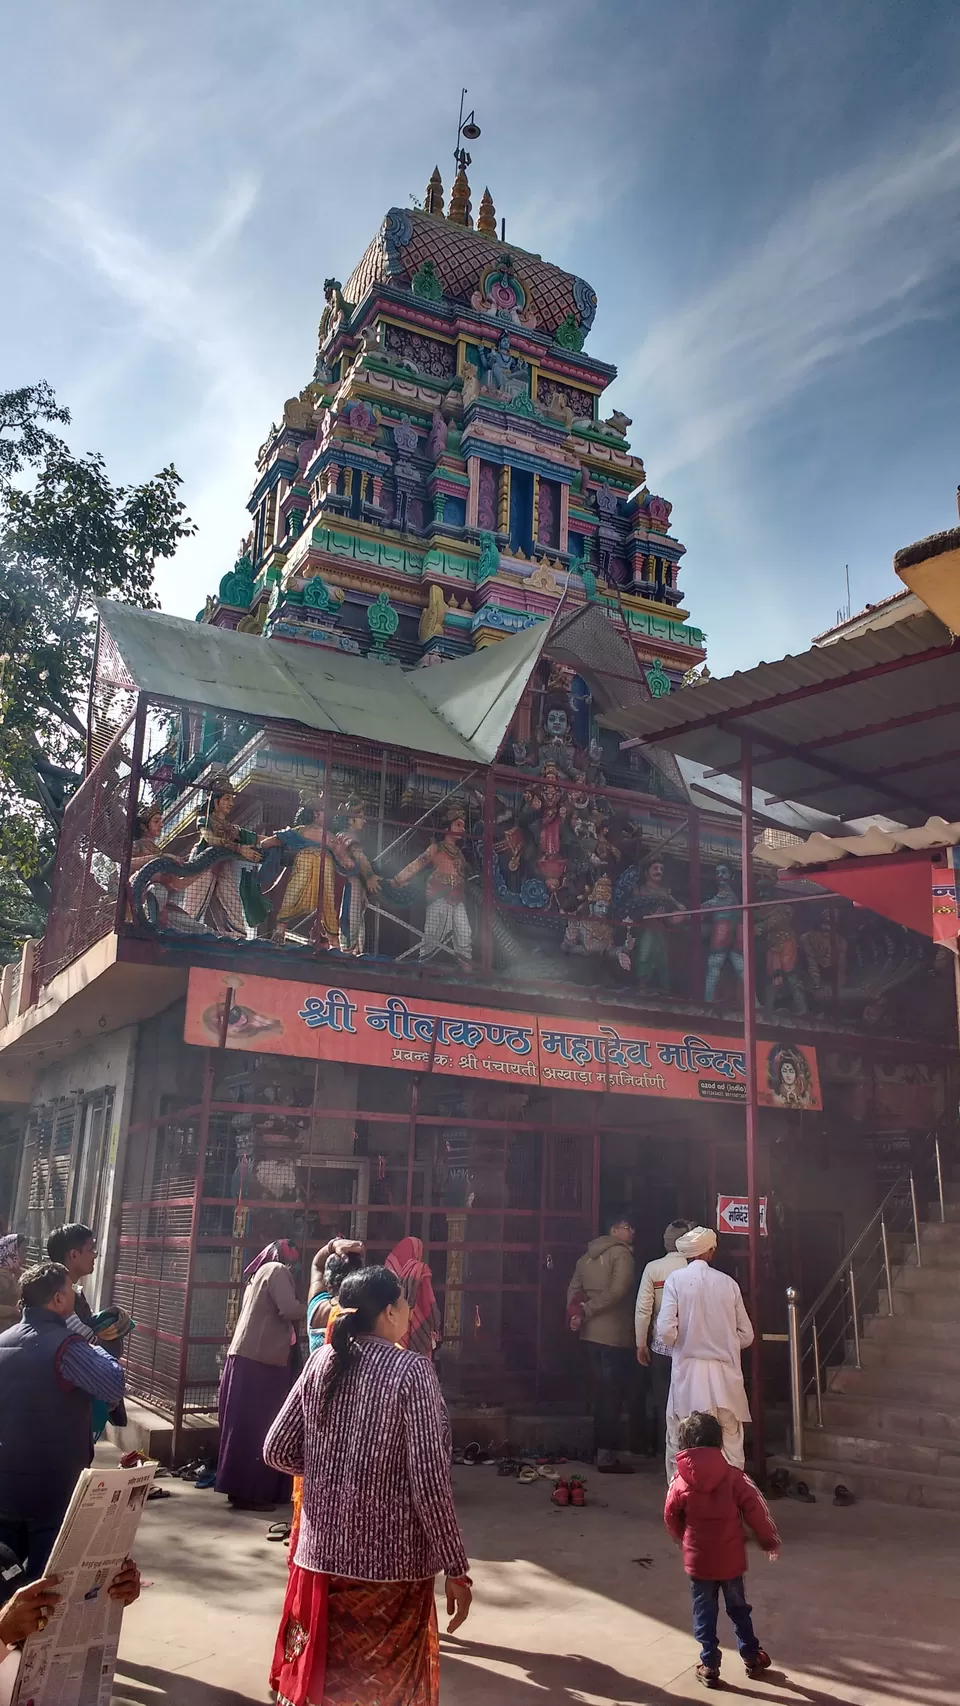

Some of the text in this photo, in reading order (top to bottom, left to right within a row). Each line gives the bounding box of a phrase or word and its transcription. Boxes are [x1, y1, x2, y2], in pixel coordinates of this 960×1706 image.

[298, 988, 357, 1033] श्री
[364, 997, 533, 1055] नीलकण्ठ
[540, 1026, 652, 1068] महादेव
[458, 1053, 479, 1070] श्री
[482, 1055, 538, 1077] पंचायती
[596, 1070, 667, 1090] महानिर्वाणी
[728, 1206, 748, 1223] मन्दिर
